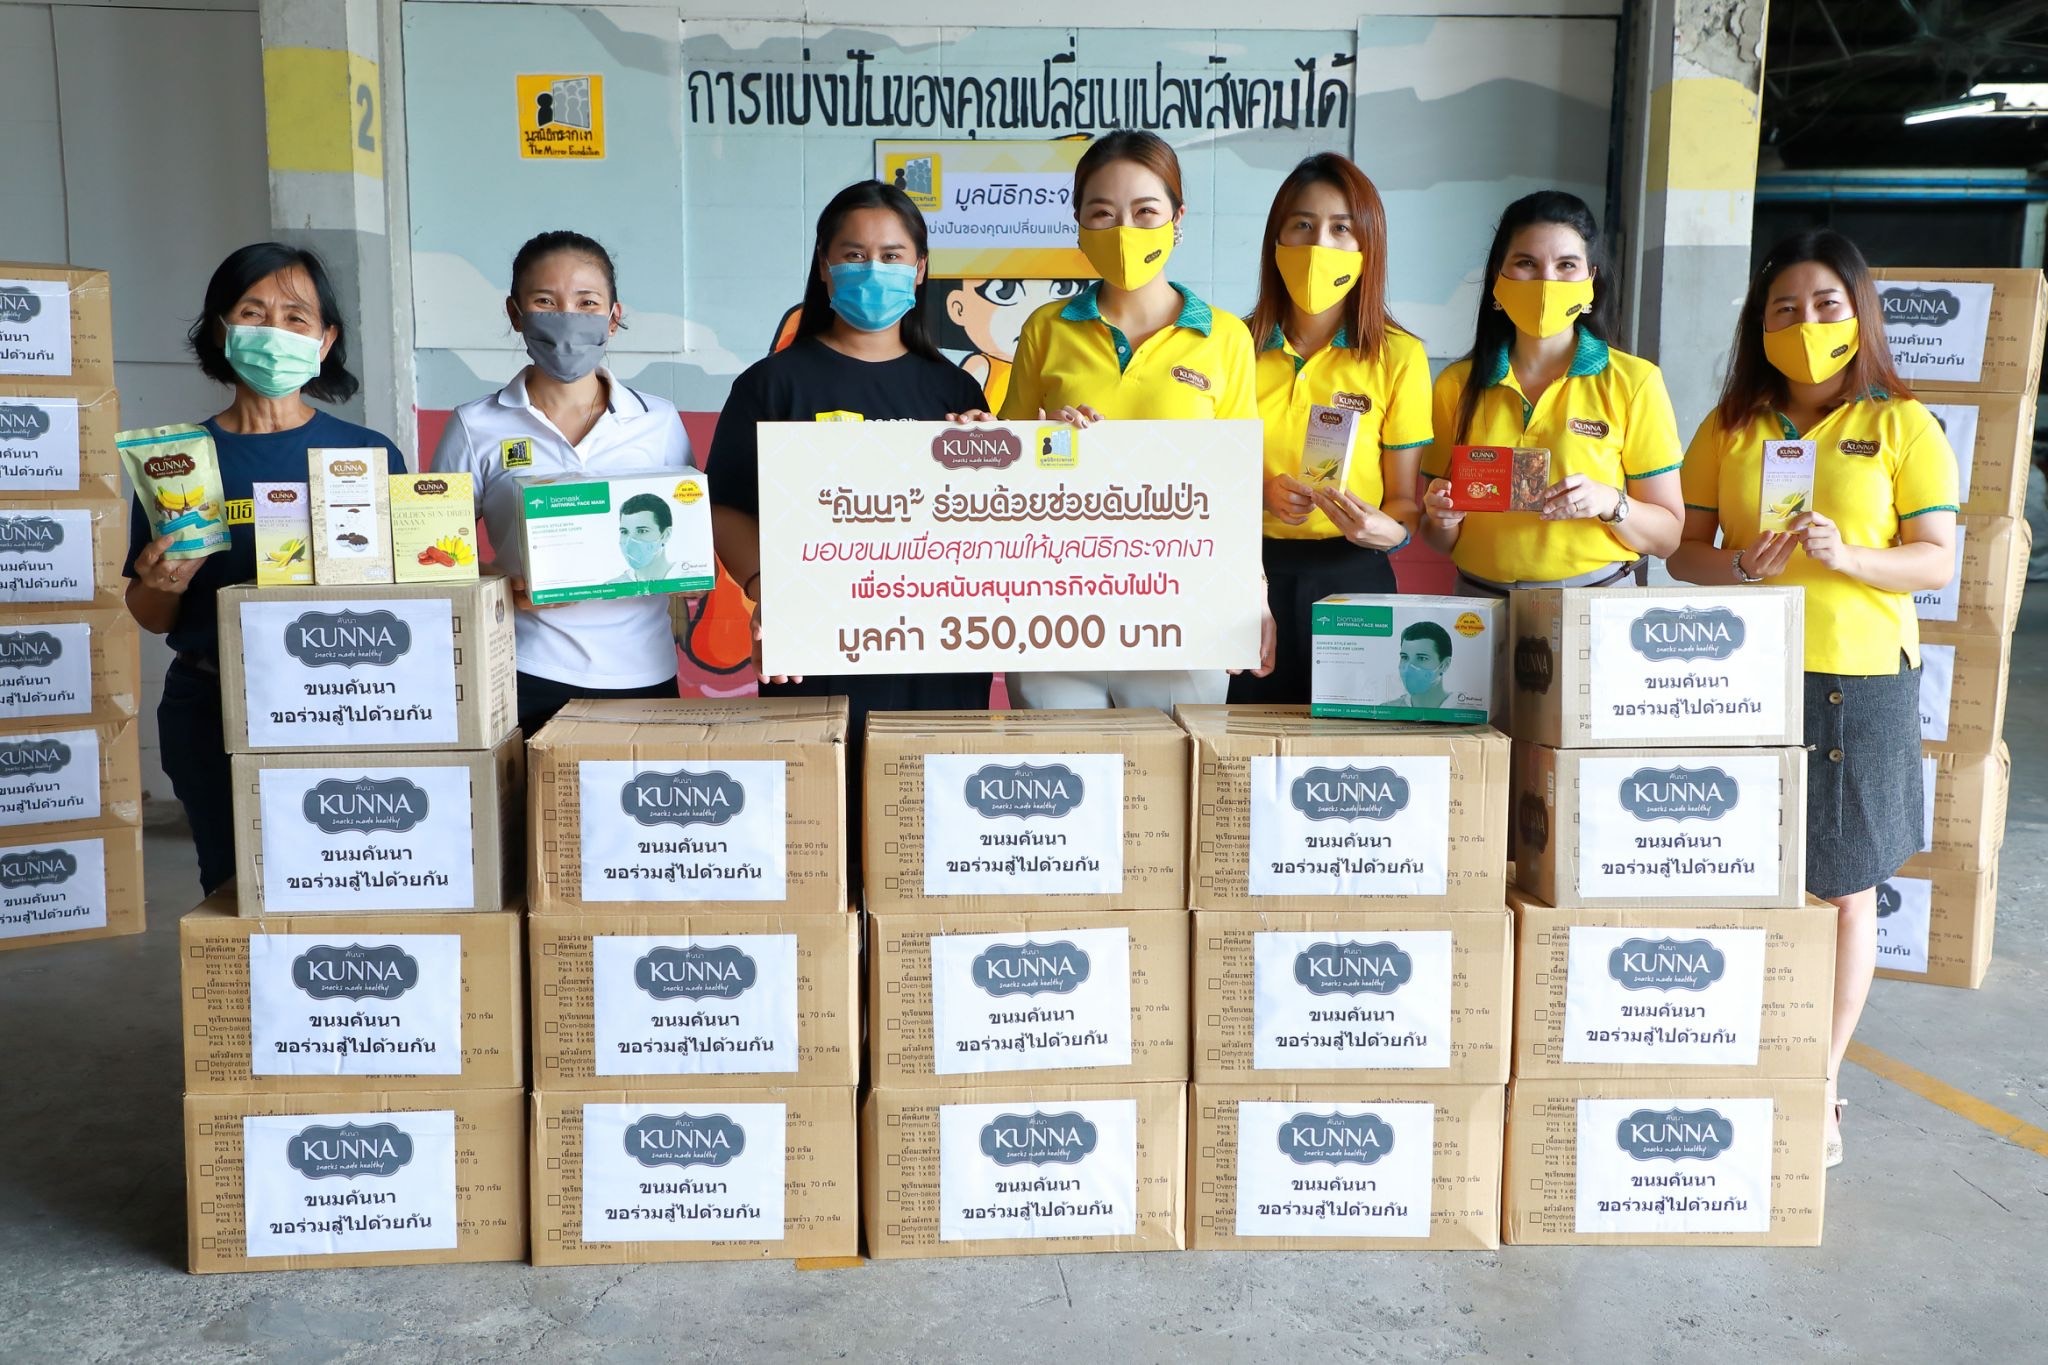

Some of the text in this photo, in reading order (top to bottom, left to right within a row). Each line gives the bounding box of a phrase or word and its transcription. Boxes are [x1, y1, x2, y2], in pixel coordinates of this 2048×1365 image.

[357, 84, 375, 152] 2
[529, 144, 543, 155] The
[544, 146, 567, 155] Mirror
[955, 184, 1069, 211] มูลนิธิกระจ
[1883, 298, 1948, 314] KUNNA
[1179, 370, 1204, 385] KUNNA
[1340, 396, 1365, 407] KUNNA
[0, 414, 40, 428] NNA
[1574, 421, 1601, 432] KUNNA
[942, 439, 1011, 456] KUNNA
[1846, 443, 1874, 451] KUNNA
[149, 458, 190, 472] KUNNA
[334, 464, 363, 472] KUNNA
[550, 495, 580, 503] biomask
[933, 482, 1209, 521] ร่วมด้วยช่วยดับไฟป่า
[0, 526, 53, 541] UNNA
[802, 531, 1214, 566] มอบขนมเพื่อสุขภาพให้มูลนิธิกระจกเงา
[851, 572, 1180, 604] เพื่อร่วมสนับสนุนภารกิจดับไฟป่า
[299, 625, 396, 648] KUNNA
[839, 614, 1182, 662] มูลค่า 350,000 บาท
[1643, 621, 1732, 643] KUNNA
[0, 641, 52, 656] UNNA
[304, 679, 395, 695] ขนมคันนา
[1645, 673, 1728, 688] ขนมคันนา
[271, 705, 432, 725] ขอร่วมสู้ไปด้วยกัน
[1613, 698, 1761, 718] ขอร่วมสู้ไปด้วยกัน
[636, 785, 730, 808] KUNNA
[979, 779, 1069, 801] KUNNA
[1305, 781, 1396, 804] KUNNA
[1633, 782, 1724, 803] KUNNA
[318, 792, 413, 815] KUNNA
[638, 838, 727, 853] ขนมคันนา
[980, 830, 1066, 845] ขนมคันนา
[1305, 833, 1391, 847] ขนมคันนา
[1635, 833, 1721, 848] ขนมคันนา
[321, 845, 412, 861] ขนมคันนา
[2, 858, 67, 877] KUNNA
[604, 863, 761, 882] ขอร่วมสู้ไปด้วยกัน
[946, 856, 1099, 875] ขอร่วมสู้ไปด้วยกัน
[1271, 857, 1423, 877] ขอร่วมสู้ไปด้วยกัน
[1602, 858, 1754, 878] ขอร่วมสู้ไปด้วยกัน
[287, 871, 448, 891] ขอร่วมสู้ไปด้วยกัน
[4, 893, 66, 907] ขนมคันนา
[308, 959, 403, 982] KUNNA
[649, 960, 742, 983] KUNNA
[986, 956, 1076, 980] KUNNA
[1308, 956, 1398, 979] KUNNA
[1622, 952, 1711, 974] KUNNA
[309, 1012, 400, 1027] ขนมคันนา
[651, 1011, 739, 1027] ขนมคันนา
[989, 1007, 1074, 1024] ขนมคันนา
[1309, 1007, 1394, 1021] ขนมคันนา
[1621, 1003, 1705, 1017] ขนมคันนา
[275, 1036, 435, 1056] ขอร่วมสู้ไปด้วยกัน
[618, 1036, 774, 1056] ขอร่วมสู้ไปด้วยกัน
[956, 1030, 1108, 1052] ขอร่วมสู้ไปด้วยกัน
[1276, 1031, 1426, 1050] ขอร่วมสู้ไปด้วยกัน
[1587, 1027, 1735, 1046] ขอร่วมสู้ไปด้วยกัน
[638, 1128, 731, 1149] KUNNA
[993, 1127, 1083, 1149] KUNNA
[1292, 1126, 1380, 1148] KUNNA
[1631, 1122, 1719, 1144] KUNNA
[302, 1138, 398, 1162] KUNNA
[639, 1179, 726, 1194] ขนมคันนา
[995, 1177, 1080, 1193] ขนมคันนา
[1292, 1176, 1375, 1191] ขนมคันนา
[1631, 1172, 1715, 1186] ขนมคันนา
[304, 1190, 395, 1206] ขนมคันนา
[1598, 1196, 1746, 1214] ขอร่วมสู้ไปด้วยกัน
[605, 1203, 760, 1222] ขอร่วมสู้ไปด้วยกัน
[962, 1200, 1112, 1220] ขอร่วมสู้ไปด้วยกัน
[1258, 1200, 1407, 1219] ขอร่วมสู้ไปด้วยกัน
[270, 1214, 431, 1235] ขอร่วมสู้ไปด้วยกัน
